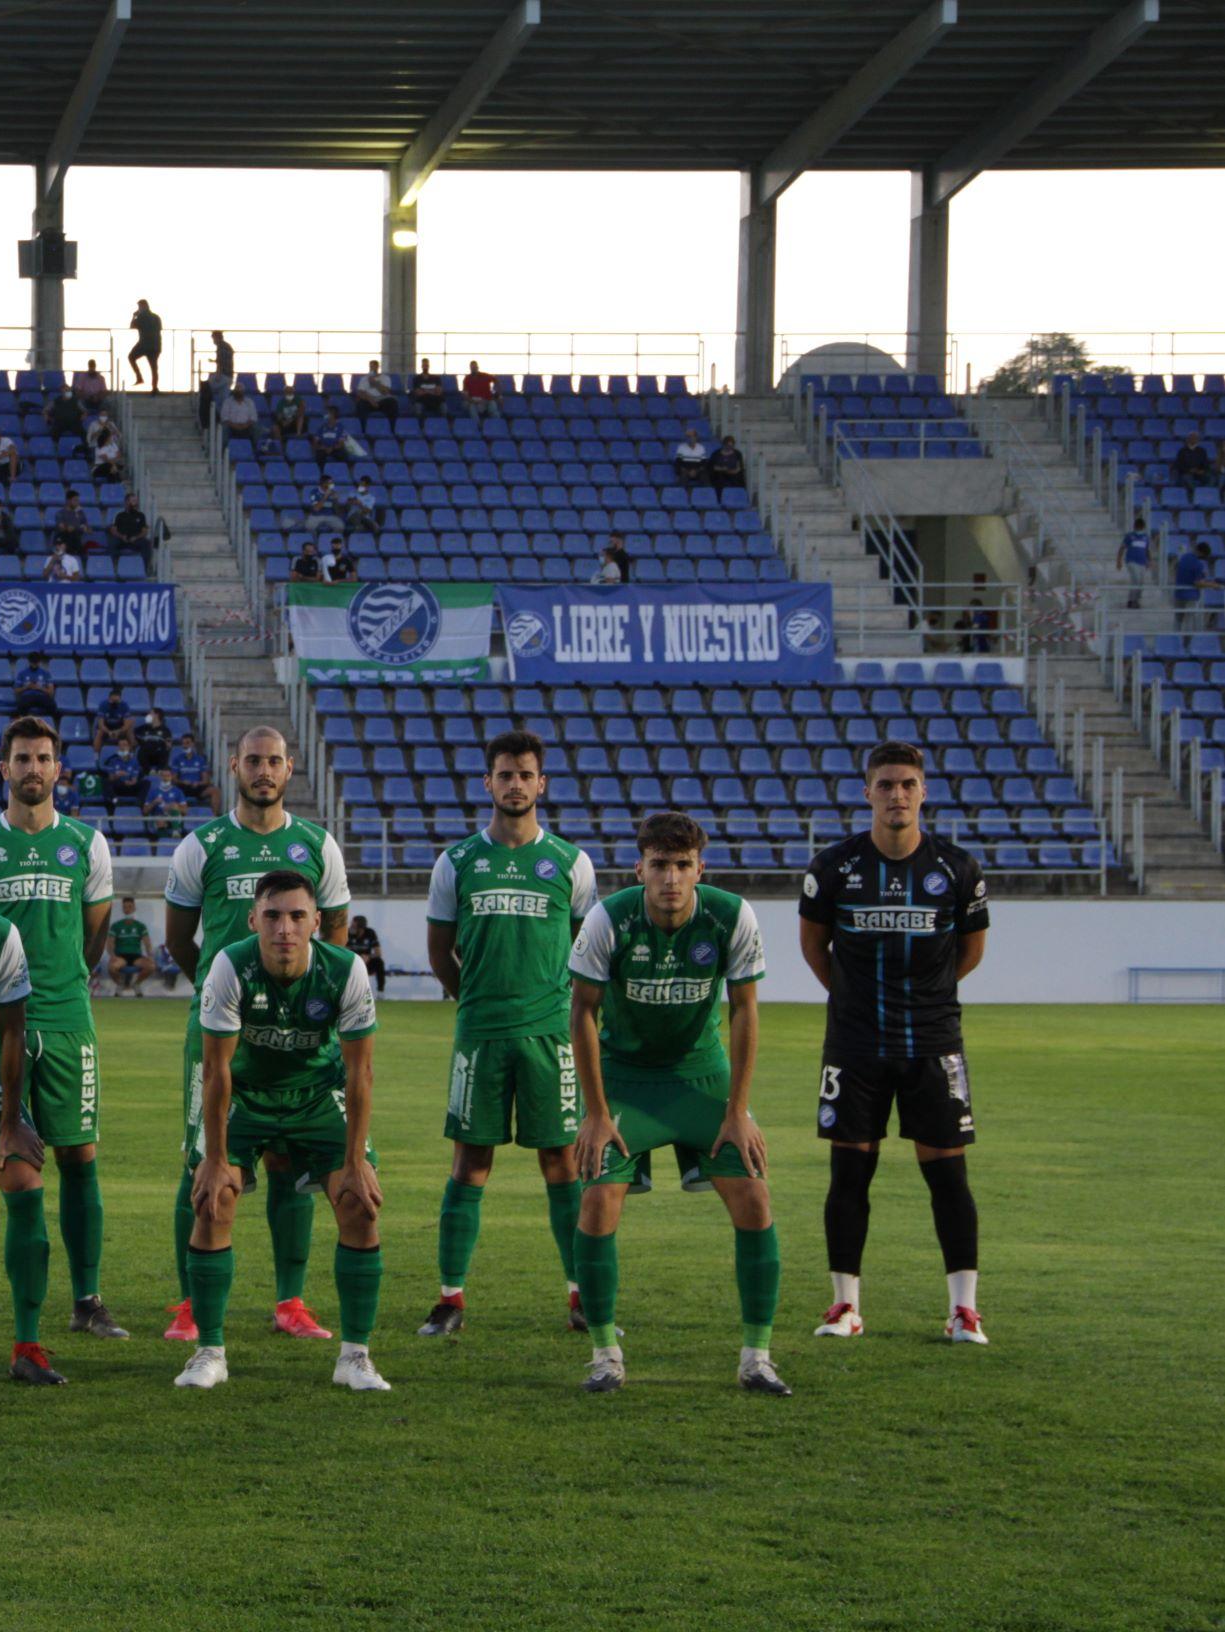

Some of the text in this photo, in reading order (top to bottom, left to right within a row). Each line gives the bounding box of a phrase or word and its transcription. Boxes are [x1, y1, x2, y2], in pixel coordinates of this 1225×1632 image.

[44, 590, 171, 645] XERECISMO
[553, 604, 632, 662] LIBRE
[638, 604, 654, 662] Y
[662, 603, 779, 662] NUESTRO
[471, 894, 549, 915] RANABE
[852, 911, 937, 930] RANABE
[626, 980, 713, 1004] RANABE
[80, 1043, 96, 1114] XEREZ
[557, 1042, 577, 1113] XEREZ
[819, 1064, 843, 1101] 13
